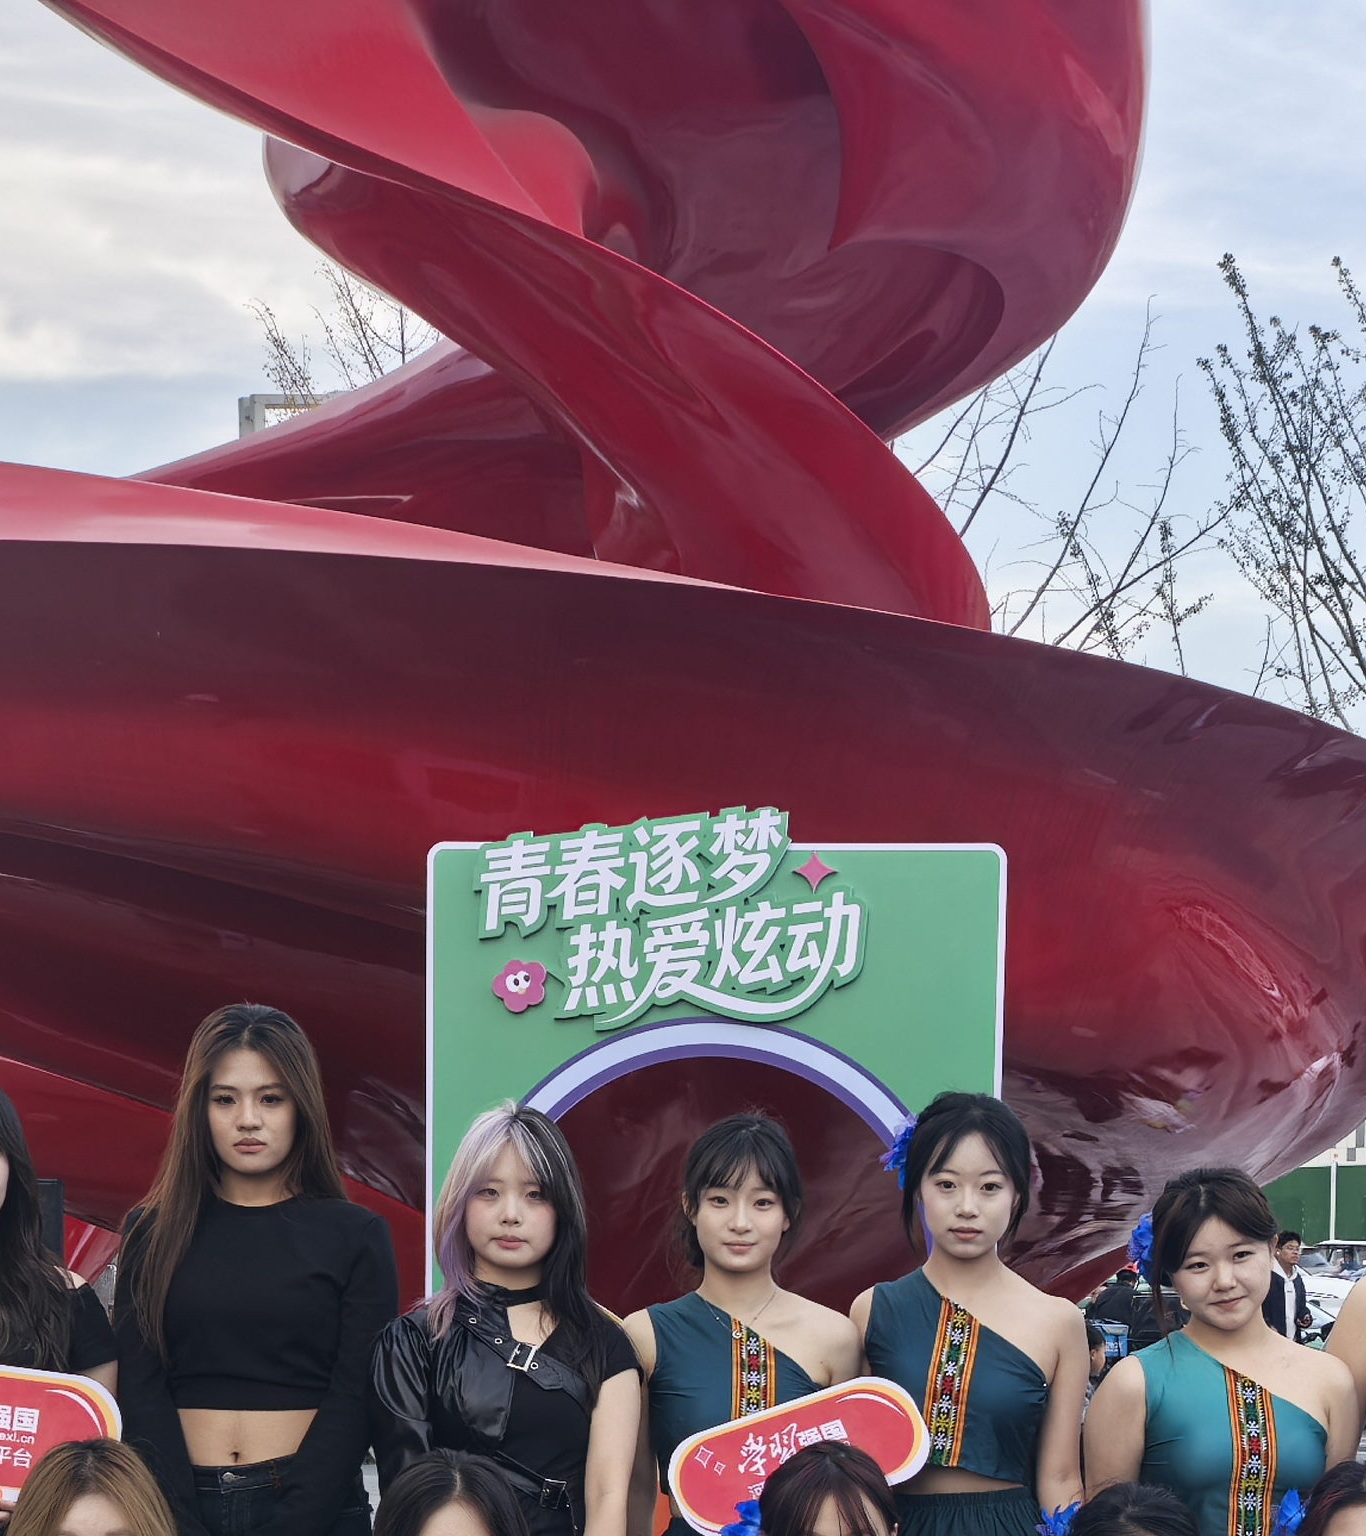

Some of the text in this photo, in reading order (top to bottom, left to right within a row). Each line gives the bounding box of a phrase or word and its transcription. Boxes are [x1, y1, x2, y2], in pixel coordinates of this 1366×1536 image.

[478, 808, 783, 931] 青春逐梦
[562, 891, 861, 1025] 热爱炫动
